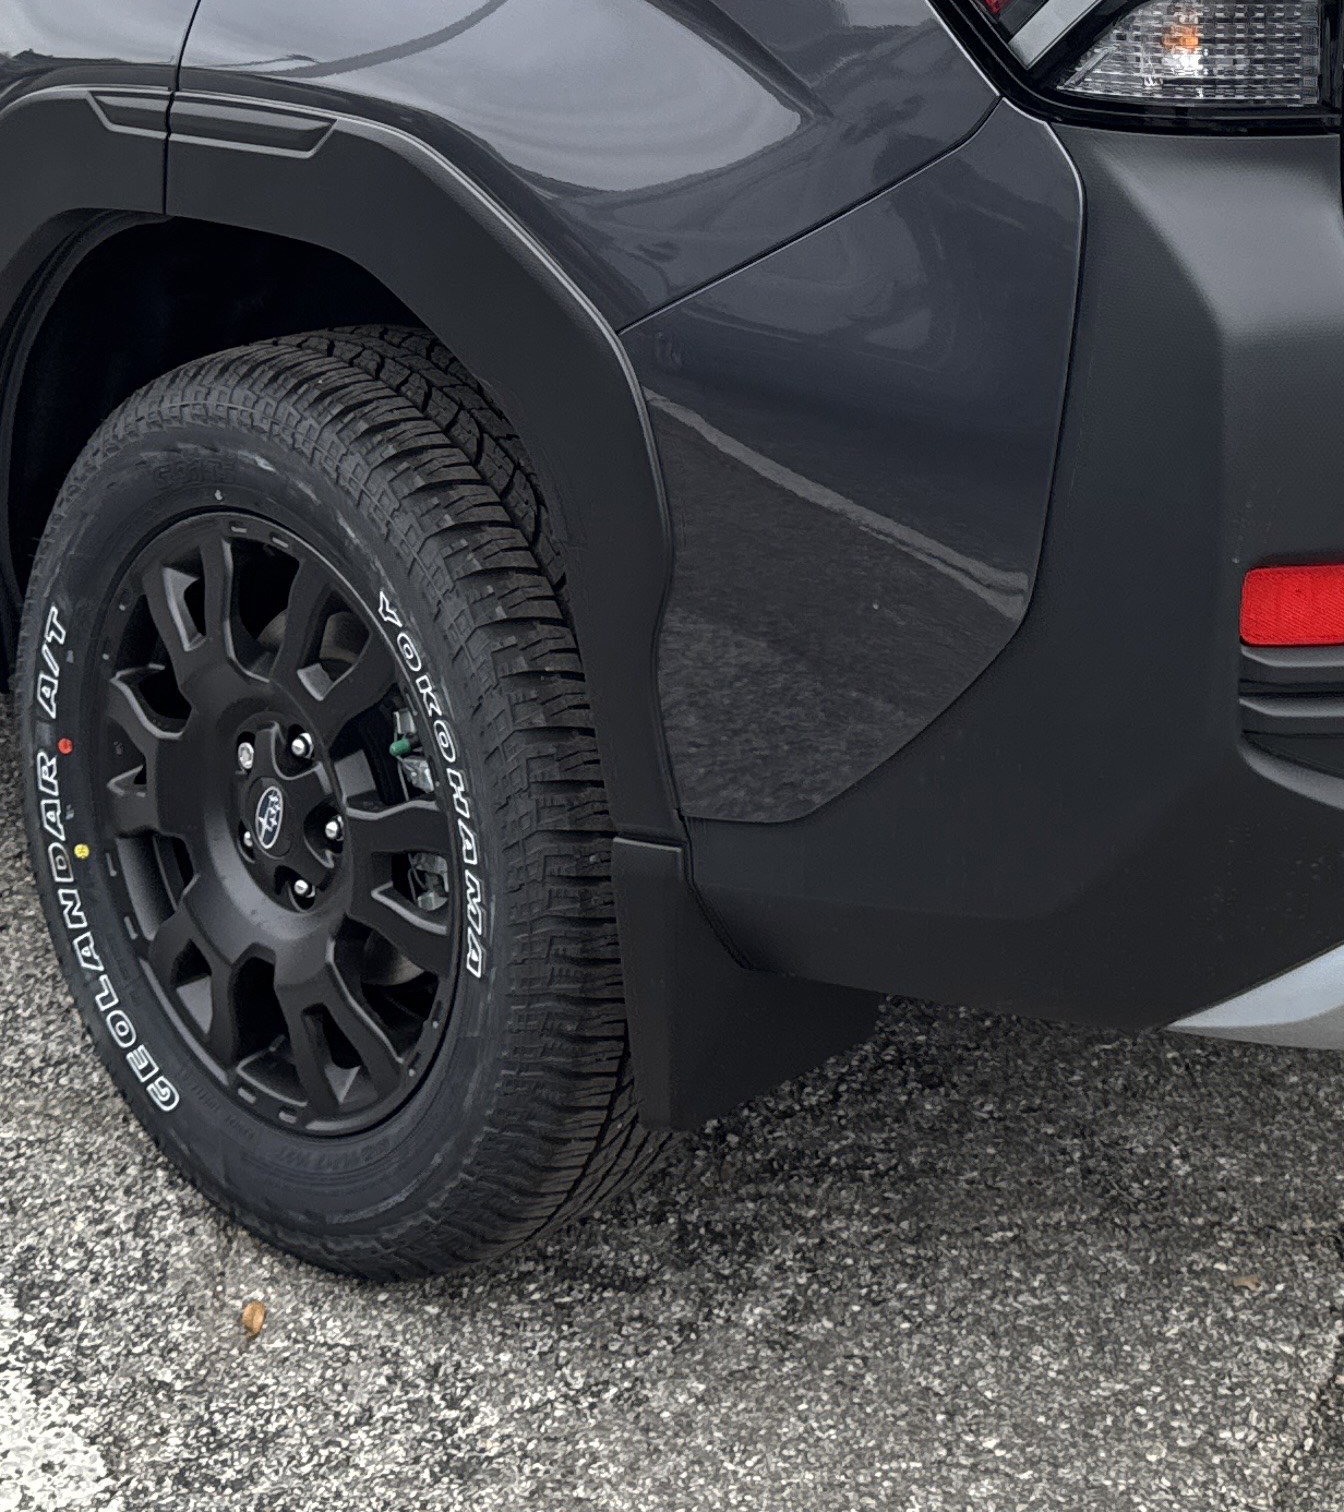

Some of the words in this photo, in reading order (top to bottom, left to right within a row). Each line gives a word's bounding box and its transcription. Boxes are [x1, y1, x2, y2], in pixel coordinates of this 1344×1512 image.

[36, 605, 69, 720] A/T
[378, 589, 483, 979] YOKOHAMA
[36, 748, 181, 1114] GEOLANDAR
